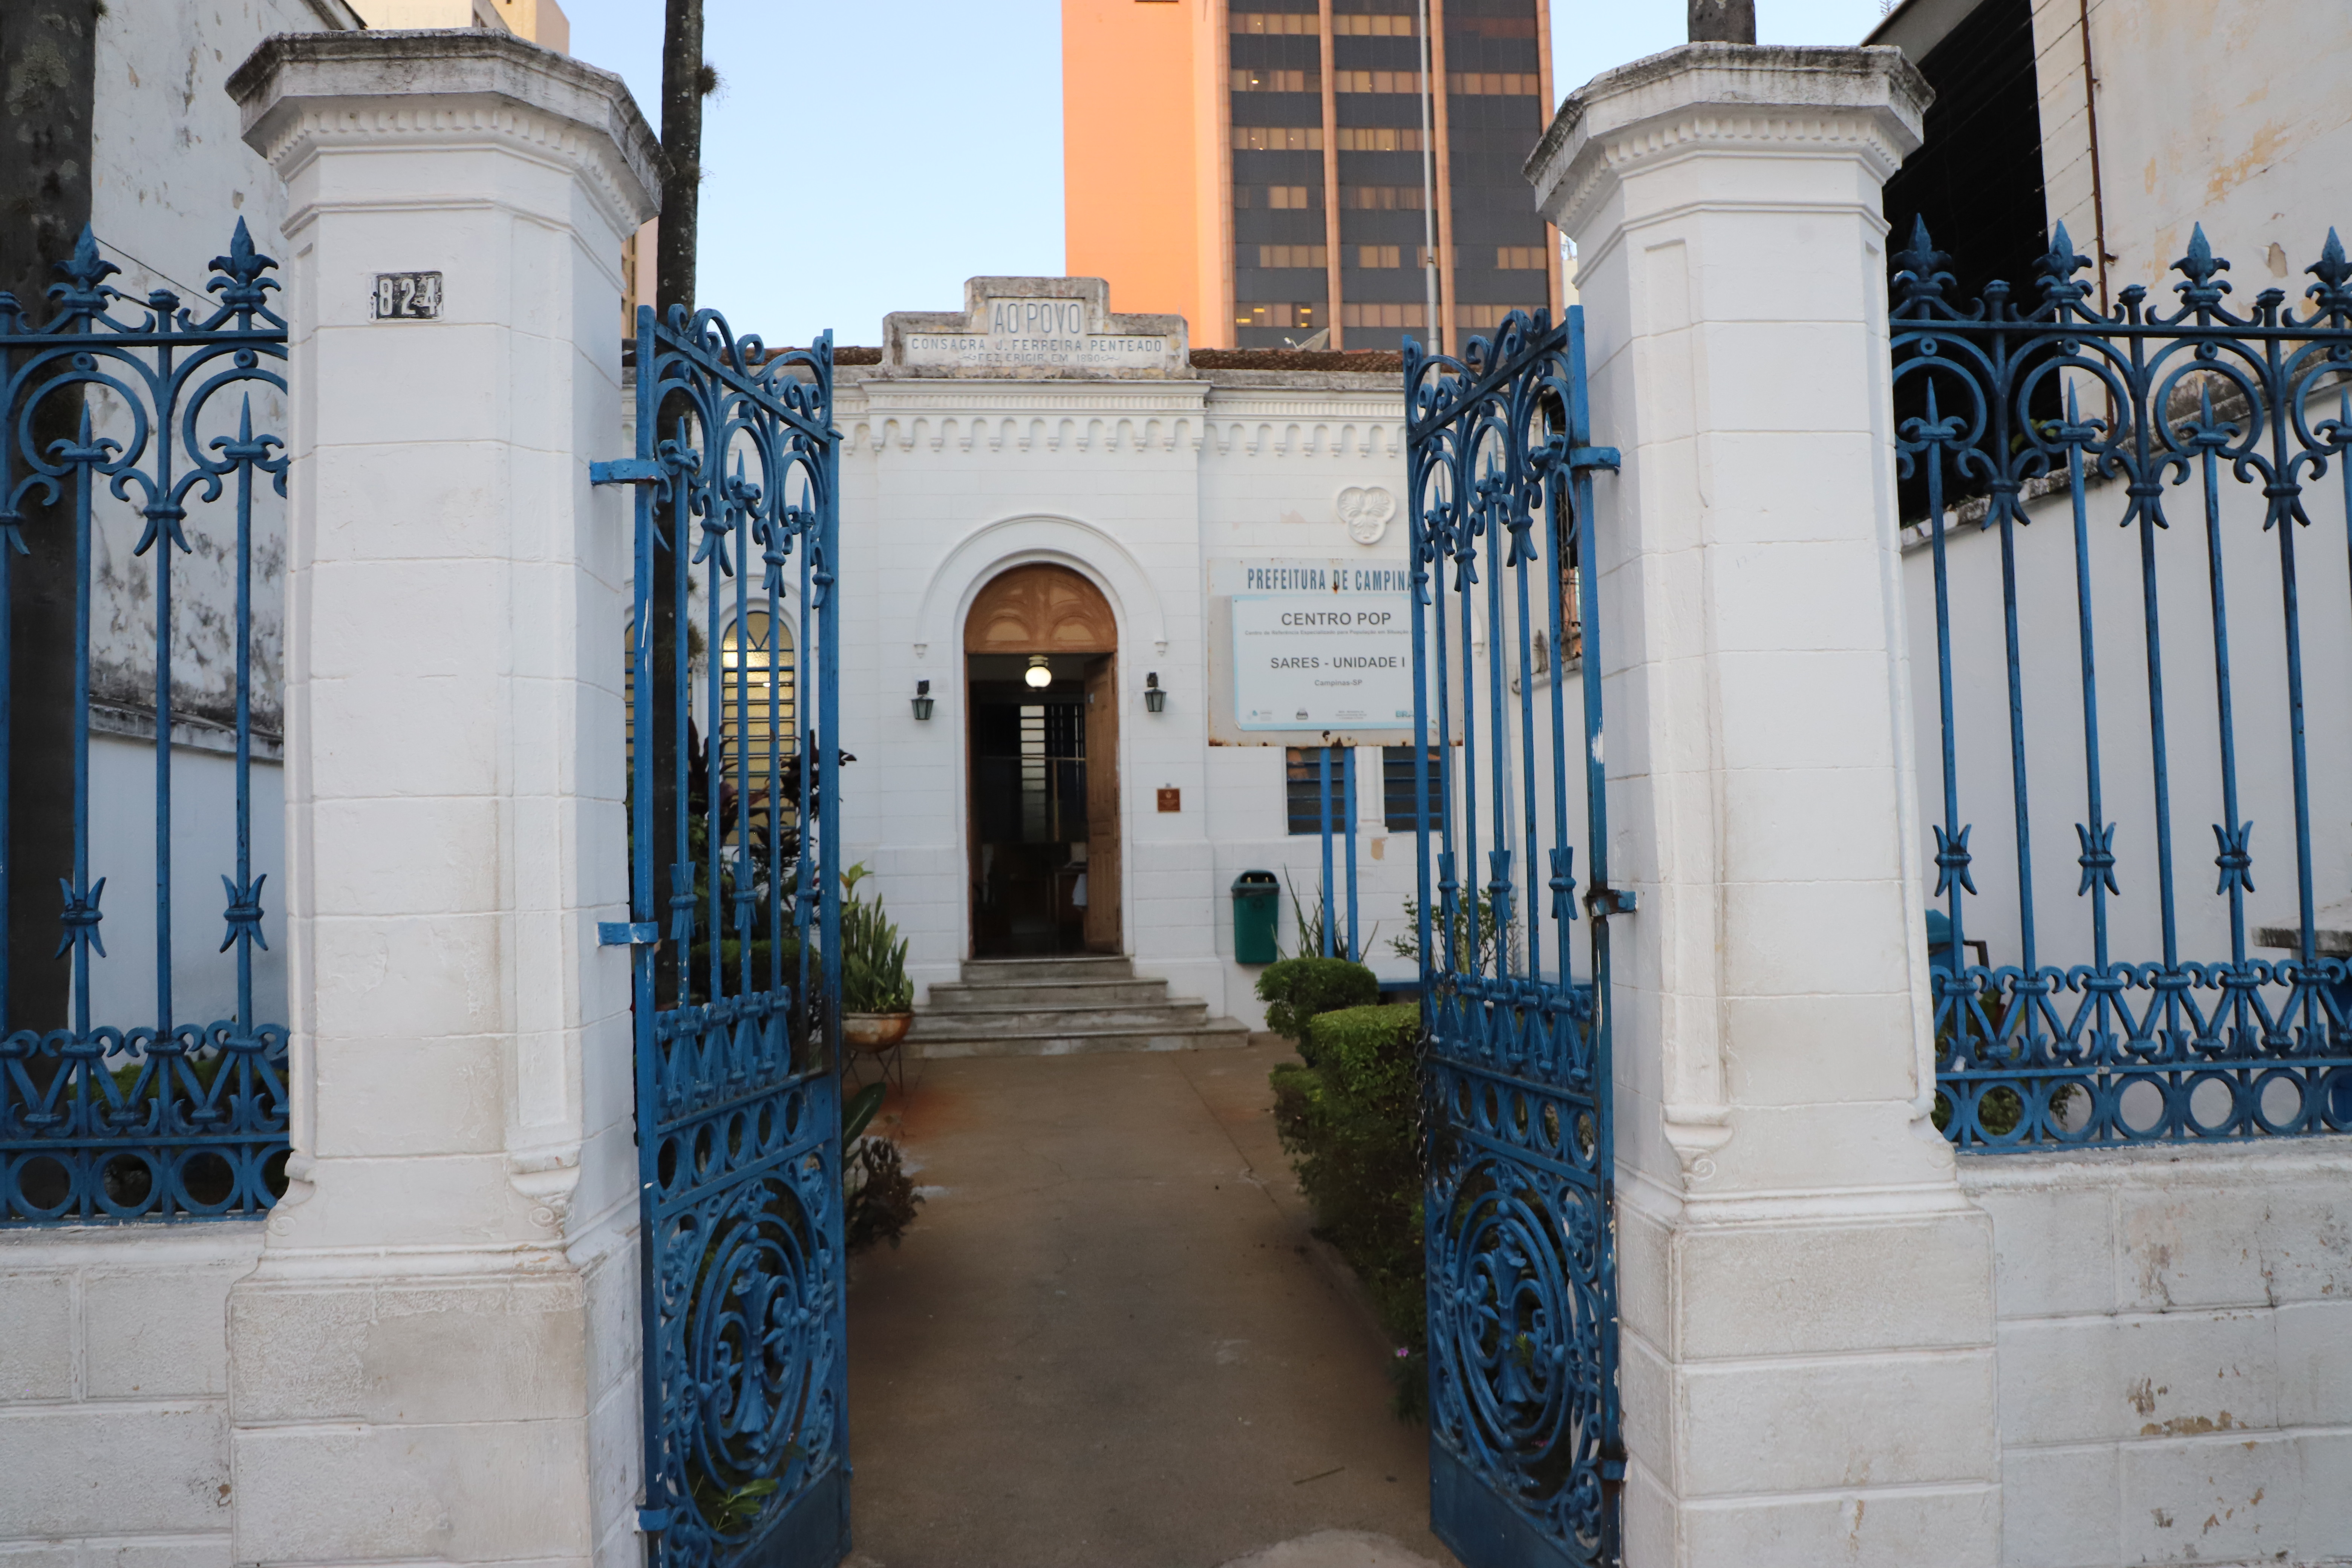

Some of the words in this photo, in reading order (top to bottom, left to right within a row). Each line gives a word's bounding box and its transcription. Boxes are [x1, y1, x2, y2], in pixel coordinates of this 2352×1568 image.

[379, 277, 436, 316] 824
[994, 303, 1018, 333] AO
[1027, 303, 1080, 334] POVO
[912, 338, 985, 350] CONSAGRA
[996, 339, 1008, 351] J.
[1013, 339, 1082, 351] FERREIRA
[1091, 340, 1162, 352] PENTEADO
[978, 353, 1000, 361] FEZ
[1006, 354, 1044, 362] ERIGIR
[1052, 354, 1069, 362] EM
[1248, 568, 1325, 590] PREFEITURA
[1334, 569, 1348, 591] DE
[1355, 570, 1411, 591] CAMPINA
[1282, 612, 1351, 625] CENTRO
[1357, 612, 1391, 625] POP
[1271, 657, 1319, 668] SARES
[1333, 657, 1397, 668] UNIDADE
